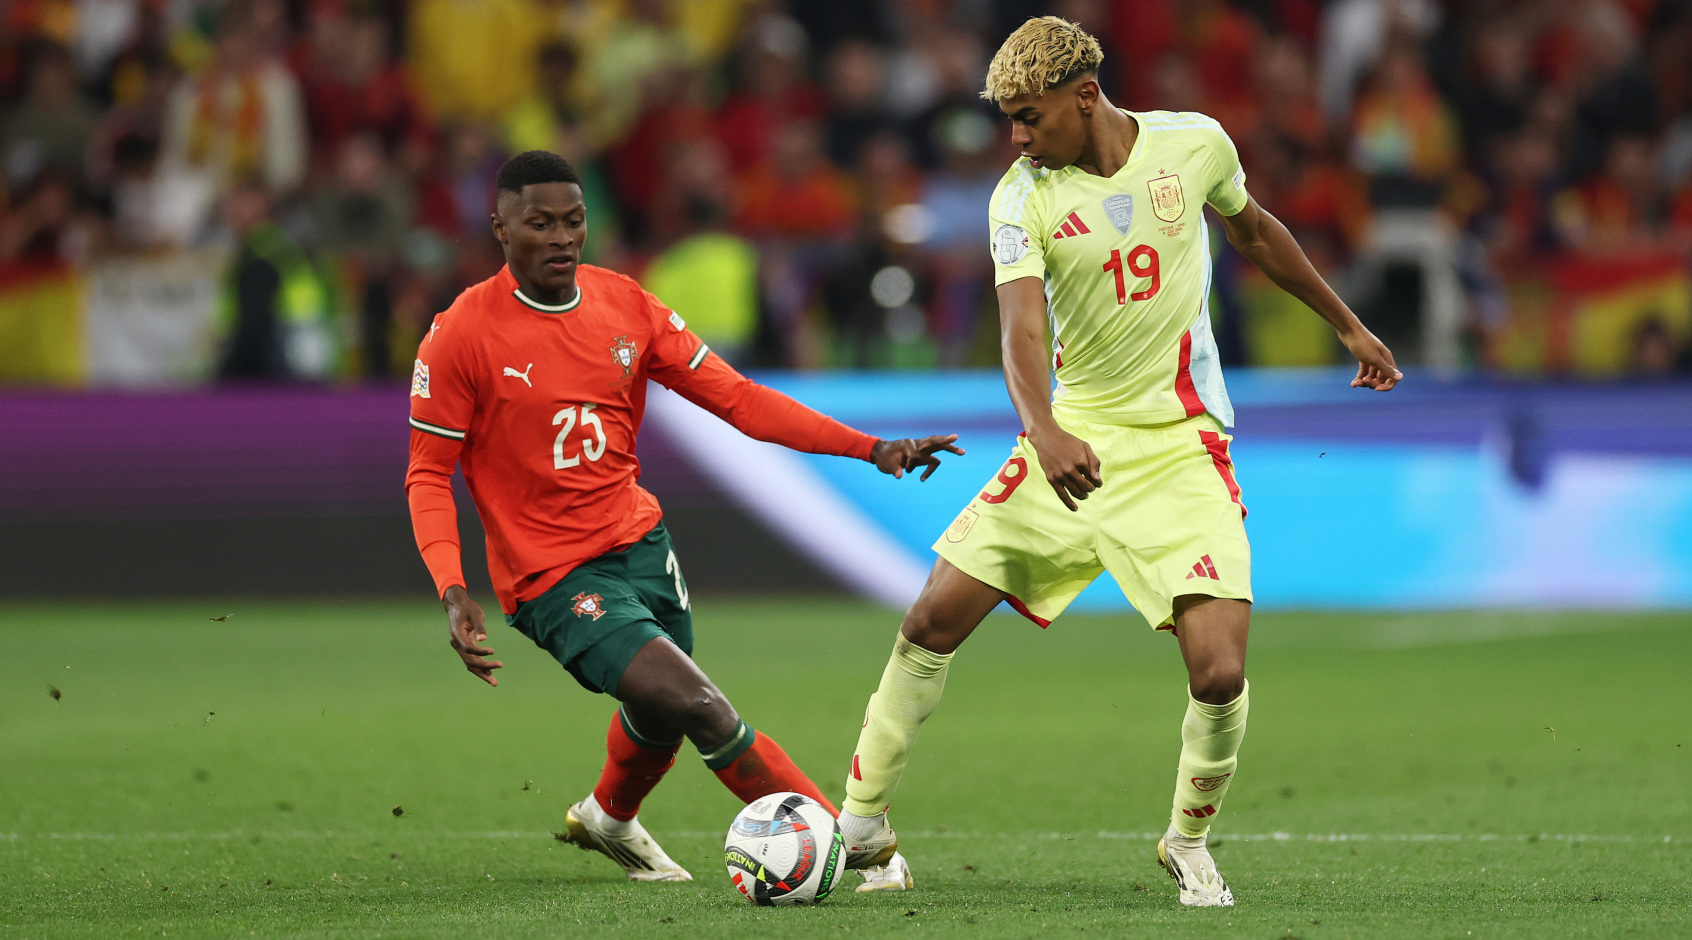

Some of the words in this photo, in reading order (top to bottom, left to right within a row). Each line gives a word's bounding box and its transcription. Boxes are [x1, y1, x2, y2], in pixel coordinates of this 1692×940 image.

[1105, 198, 1131, 207] EUROPEAN
[1103, 244, 1160, 305] 19
[552, 402, 607, 469] 25
[666, 549, 692, 614] 2
[792, 839, 813, 881] LEAGUE
[821, 841, 840, 891] NATIONS
